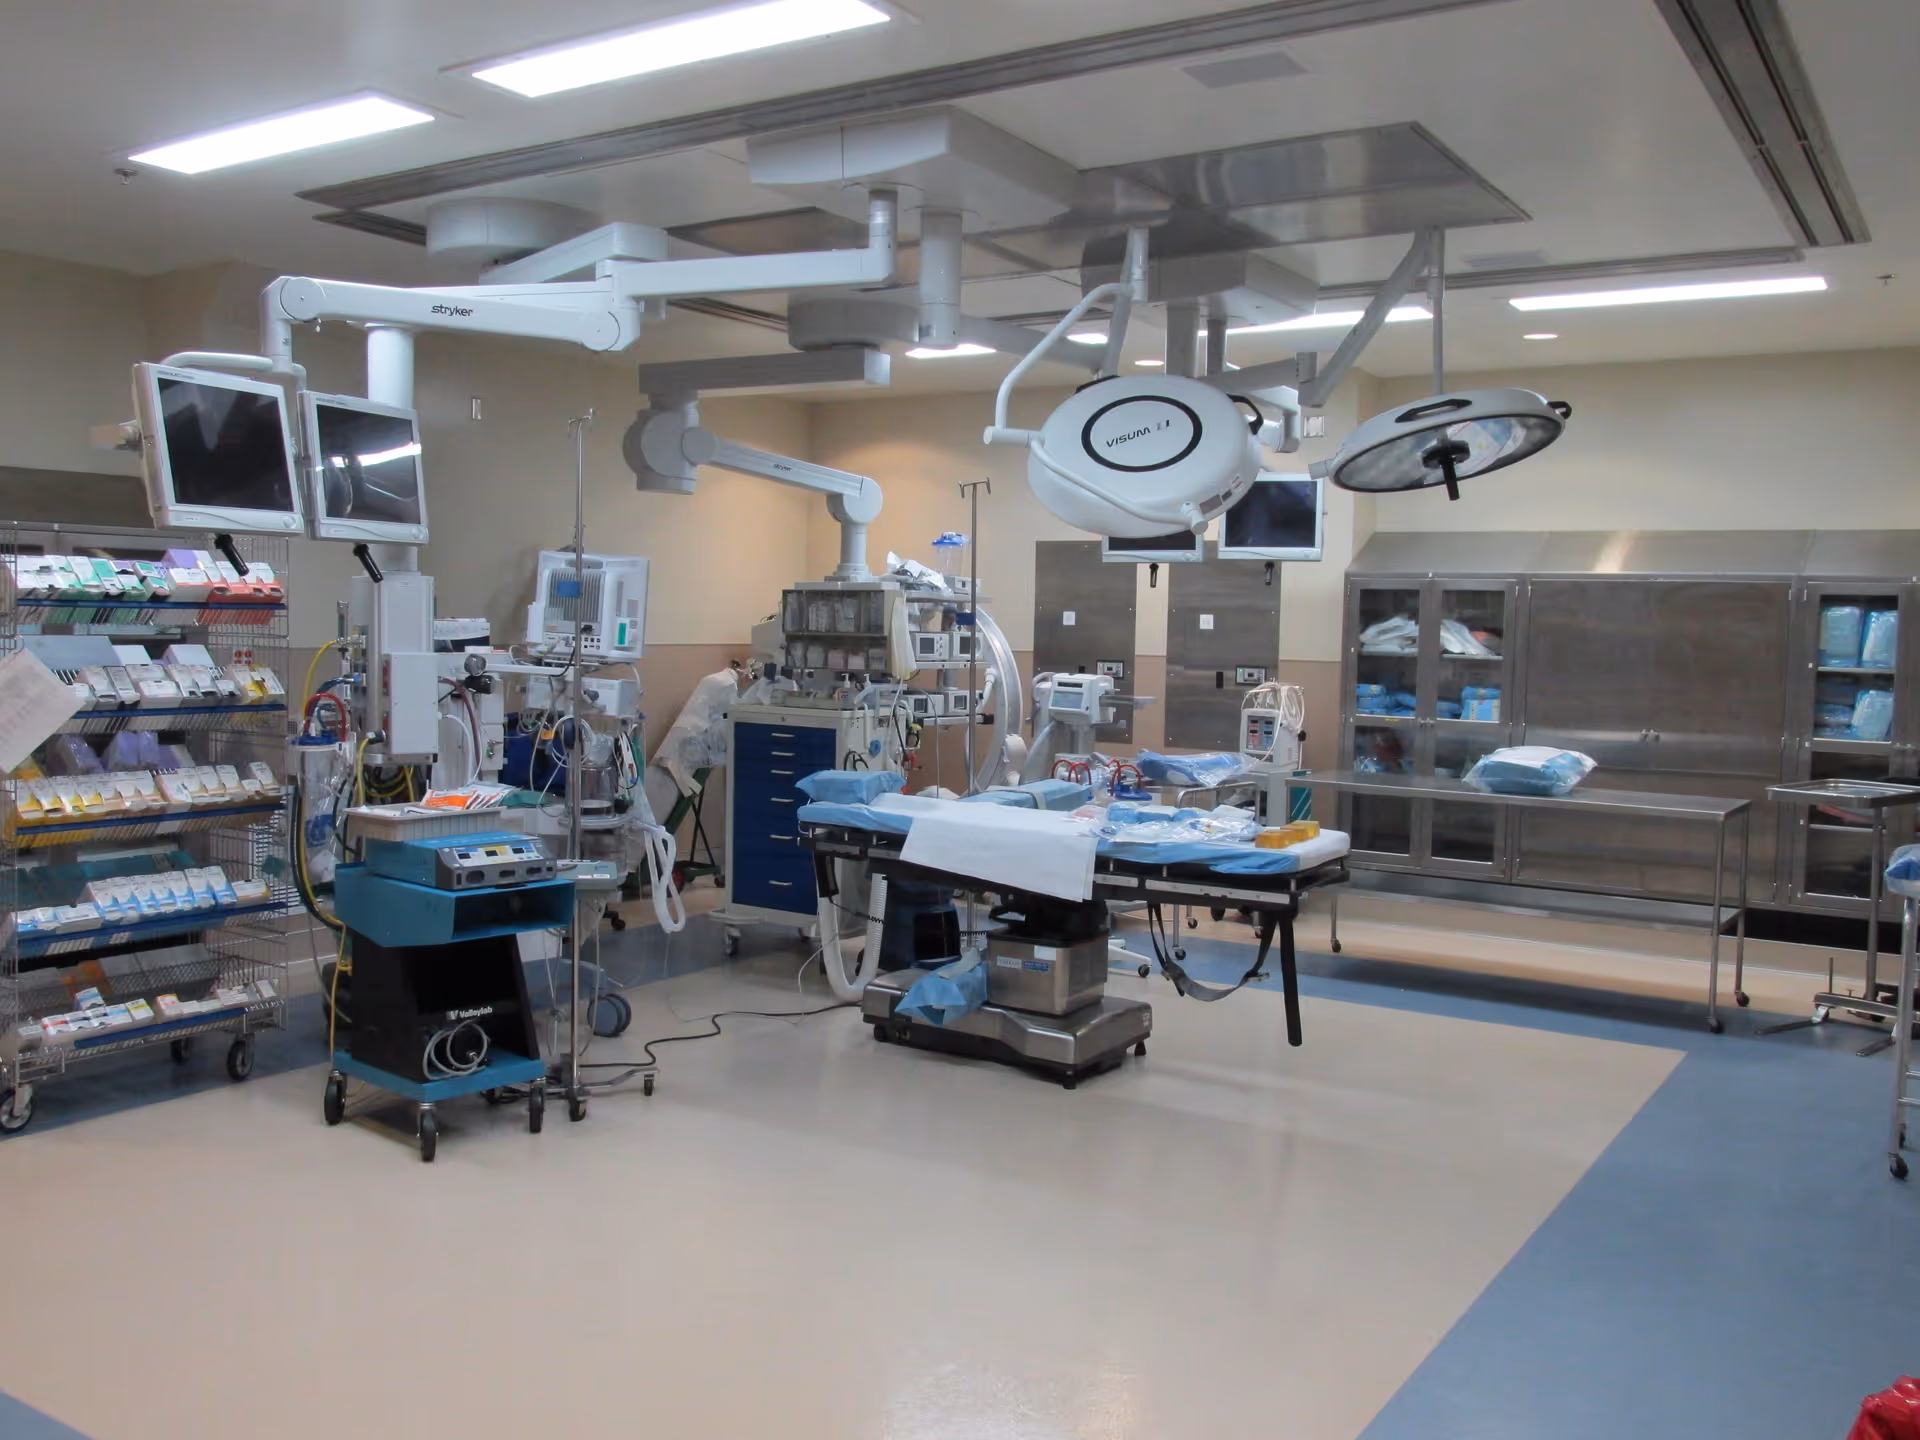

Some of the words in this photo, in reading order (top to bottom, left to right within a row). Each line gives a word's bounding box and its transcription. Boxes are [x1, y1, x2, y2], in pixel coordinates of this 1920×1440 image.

[431, 304, 473, 316] stryker
[1106, 427, 1151, 447] VISUM
[459, 1006, 493, 1018] Valleylab
